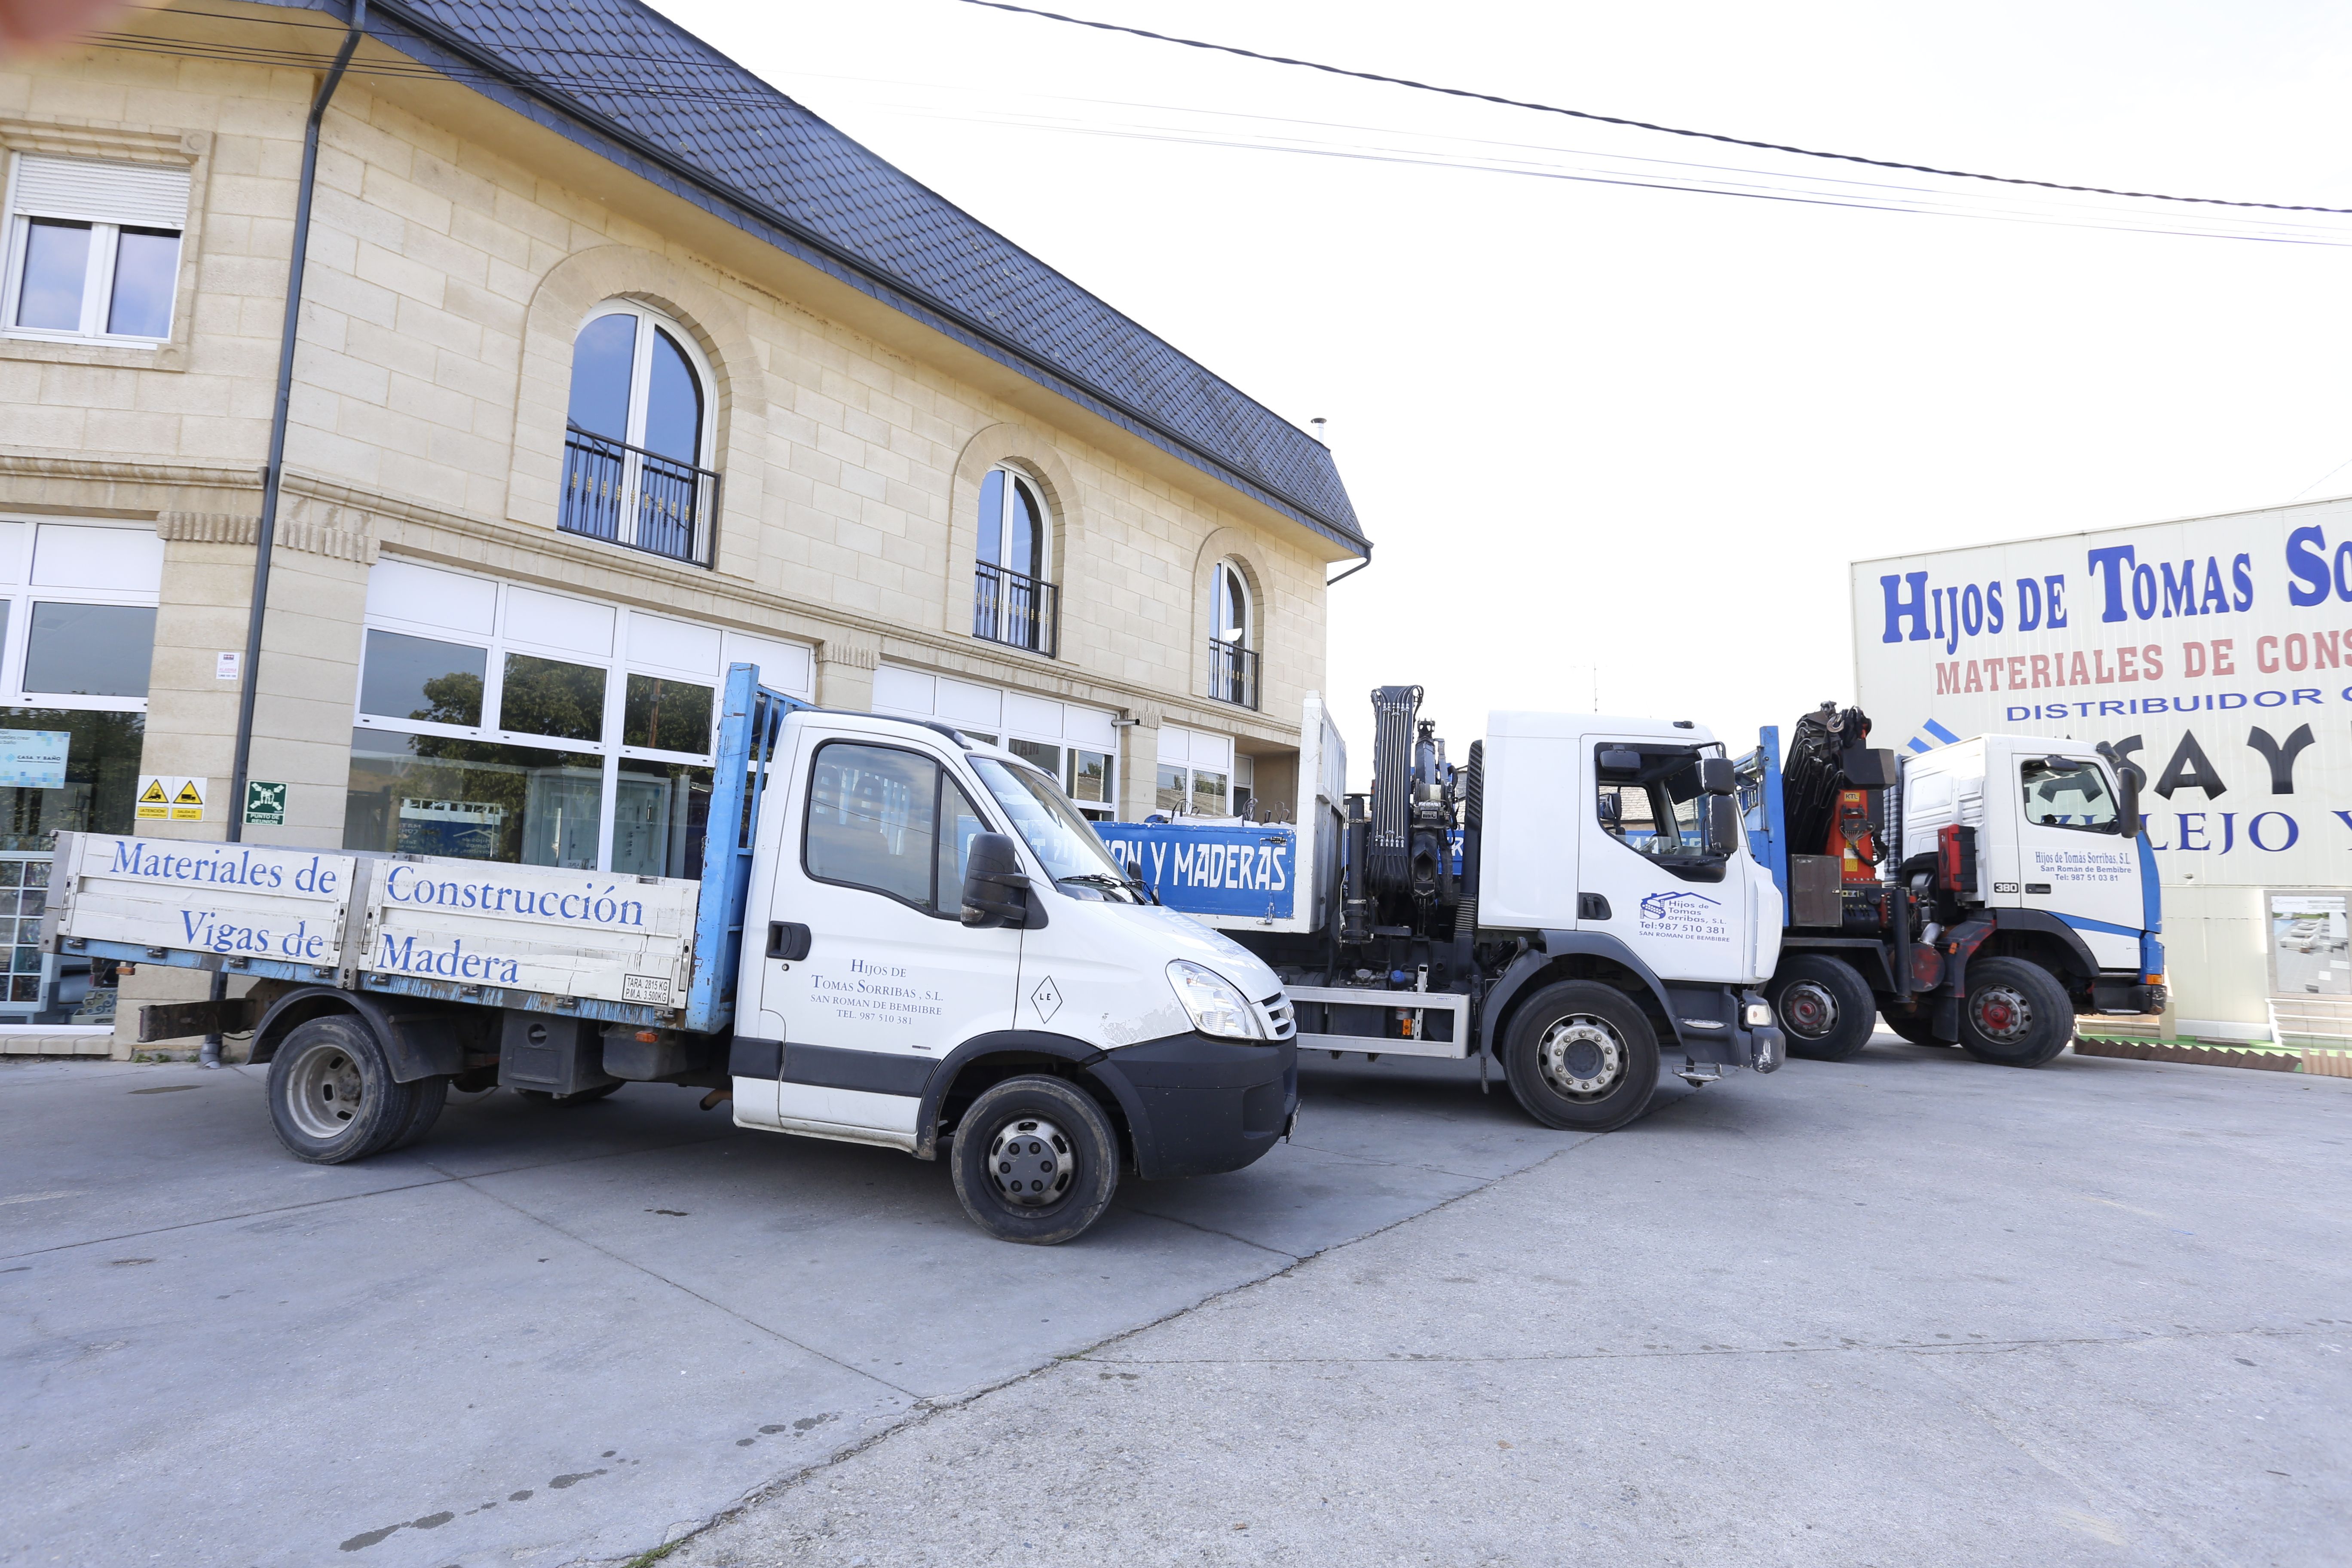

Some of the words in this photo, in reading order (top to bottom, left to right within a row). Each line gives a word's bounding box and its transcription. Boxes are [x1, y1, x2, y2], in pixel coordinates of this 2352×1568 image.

[1880, 571, 2004, 655] HIJOS
[2016, 574, 2067, 631] DE
[2088, 545, 2253, 623] TOMAS
[1936, 644, 2164, 695] MATERIALES
[2184, 639, 2235, 678] DE
[2007, 688, 2323, 721] DISTRIBUIDOR
[2247, 723, 2315, 795] Y
[1150, 841, 1167, 885] Y
[1173, 842, 1286, 891] MADERAS
[2035, 851, 2054, 865] Hijos
[2055, 852, 2063, 863] de
[2063, 851, 2086, 864] Tomás
[110, 840, 284, 888] Materiales
[295, 855, 337, 894] de
[387, 865, 643, 926] Construcción
[1995, 883, 2017, 892] 380
[1669, 900, 1695, 908] Hijos
[1669, 907, 1702, 916] Tomas
[1682, 925, 1702, 933] 510
[1706, 926, 1725, 934] 381
[180, 910, 270, 953] Vigas
[282, 920, 324, 959] de
[376, 934, 520, 983] Madera
[850, 959, 888, 977] HIJOS
[891, 967, 907, 978] DE
[625, 988, 642, 999] P.M.A.
[627, 977, 643, 989] TARA.
[644, 980, 658, 990] 2815
[658, 981, 668, 991] KG
[811, 974, 854, 992] TOMAS
[925, 990, 944, 1001] S.L.
[810, 994, 830, 1003] SAN
[832, 996, 870, 1008] ROMAN
[873, 1001, 887, 1010] DE
[889, 1002, 943, 1016] BEMBIBRE
[836, 1009, 857, 1019] TEL.
[859, 1011, 876, 1021] 987
[878, 1014, 894, 1023] 510
[897, 1016, 912, 1025] 381
